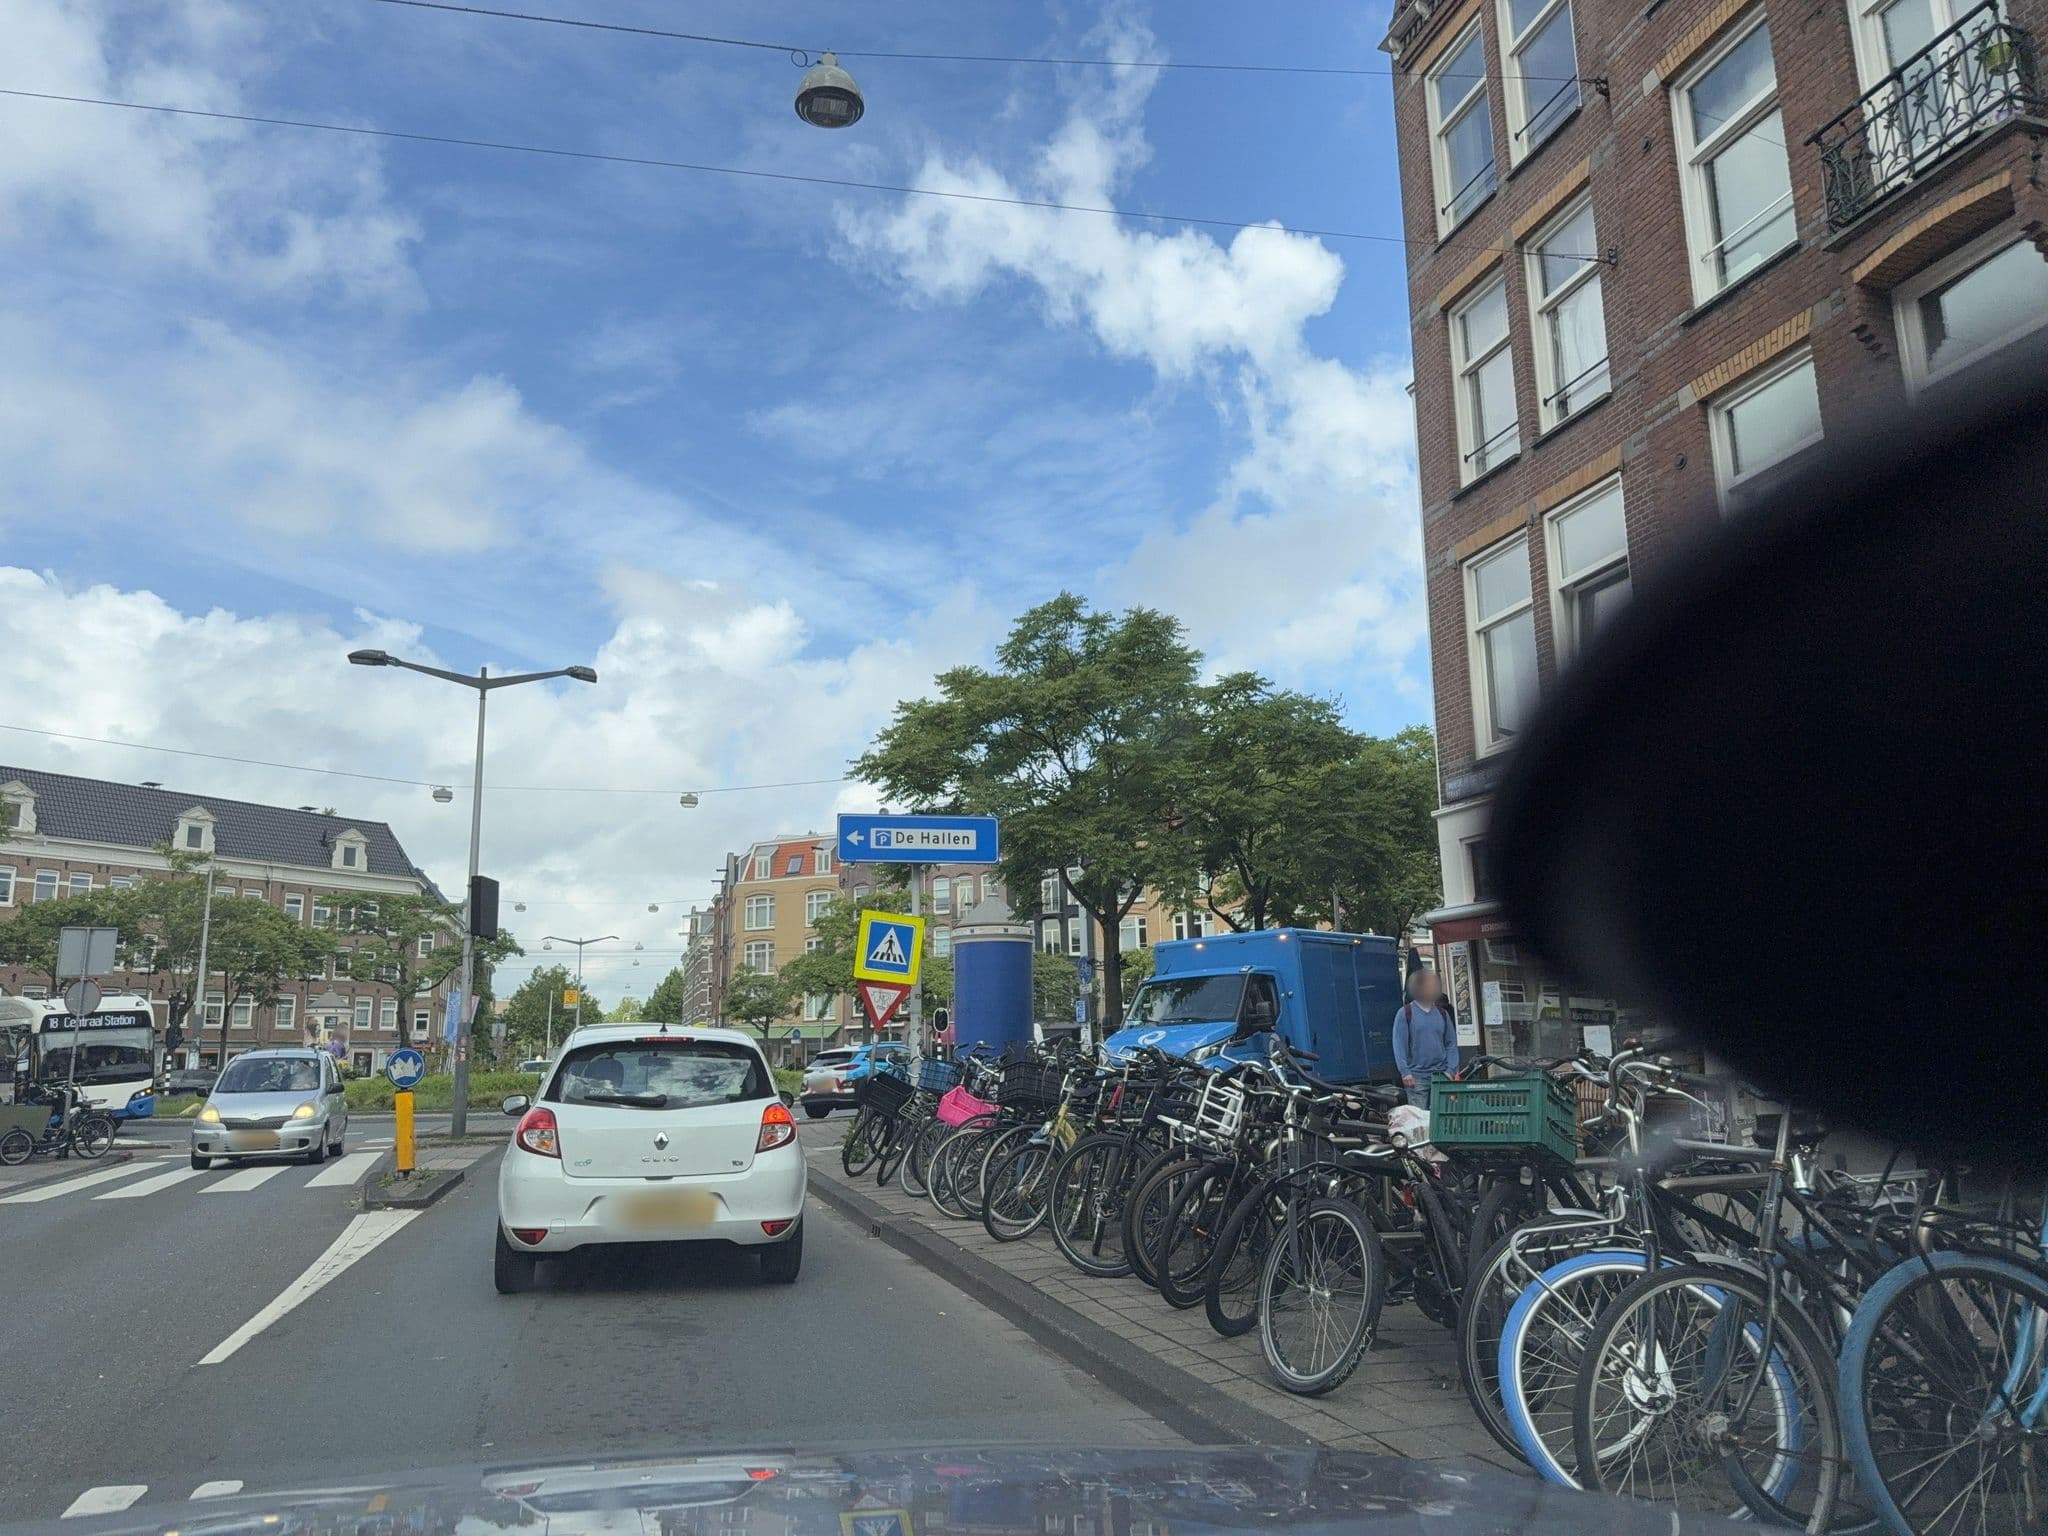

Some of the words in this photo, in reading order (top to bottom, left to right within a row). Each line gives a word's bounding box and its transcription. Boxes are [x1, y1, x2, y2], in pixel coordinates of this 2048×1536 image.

[895, 832, 914, 844] De
[921, 832, 970, 845] Hallen
[49, 1017, 59, 1029] 18
[104, 1015, 136, 1026] Station
